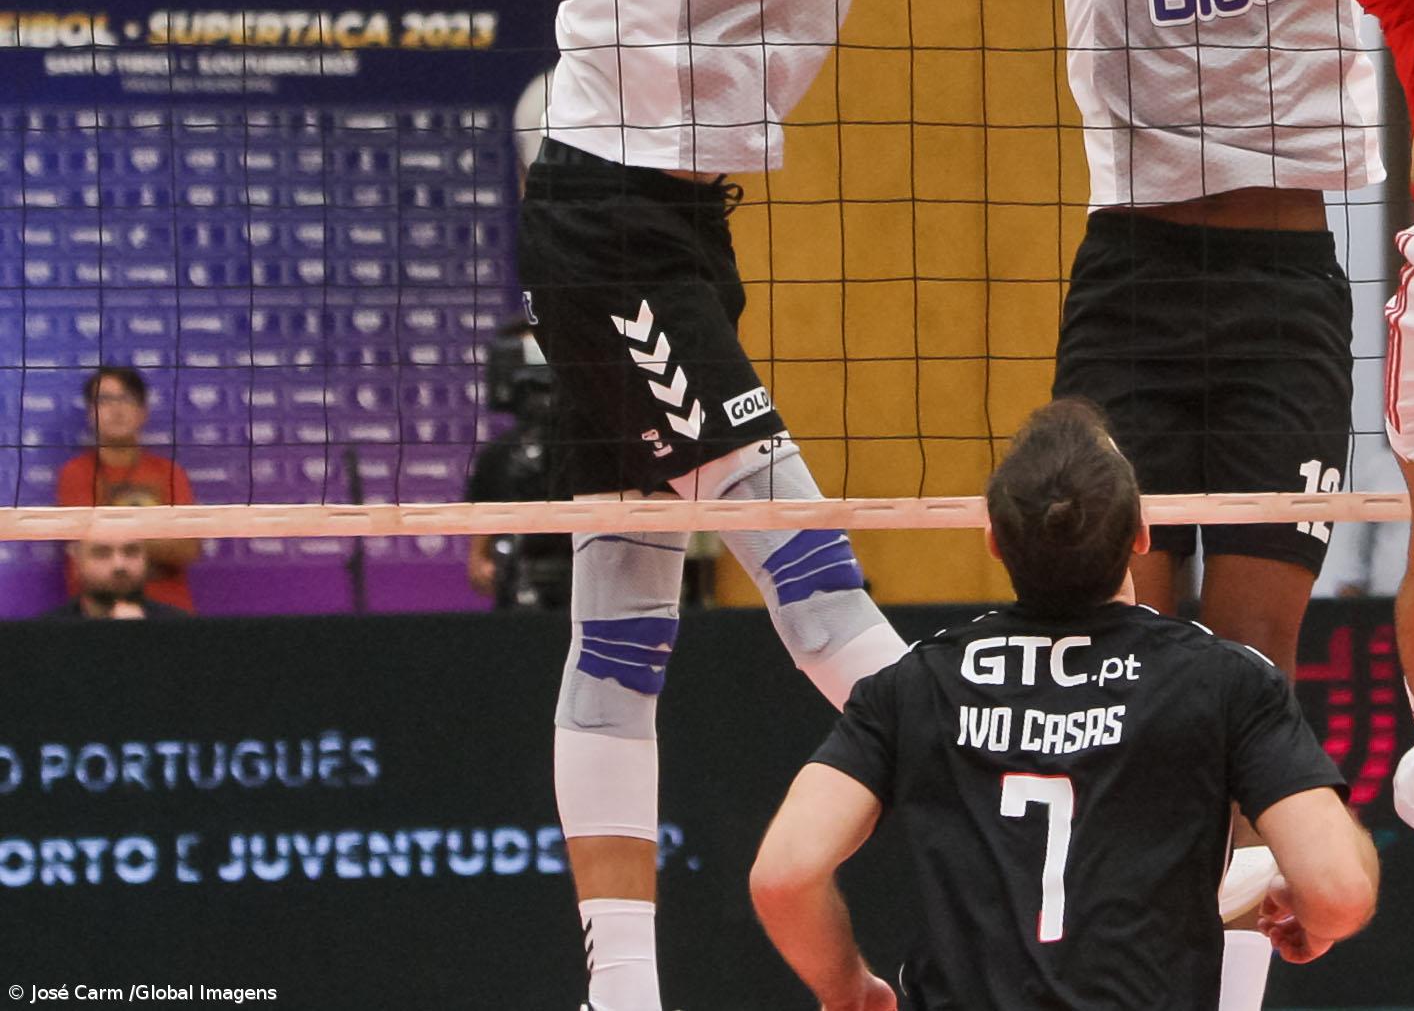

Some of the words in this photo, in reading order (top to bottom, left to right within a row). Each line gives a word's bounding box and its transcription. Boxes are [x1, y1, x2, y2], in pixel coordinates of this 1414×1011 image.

[400, 11, 497, 49] 2023
[960, 636, 1142, 687] GTC.pt
[957, 705, 1013, 752] IVO
[1020, 705, 1127, 755] CASAS
[40, 730, 381, 790] PORTUGUÊS
[0, 836, 158, 887] ORTO
[1000, 772, 1075, 943] 7
